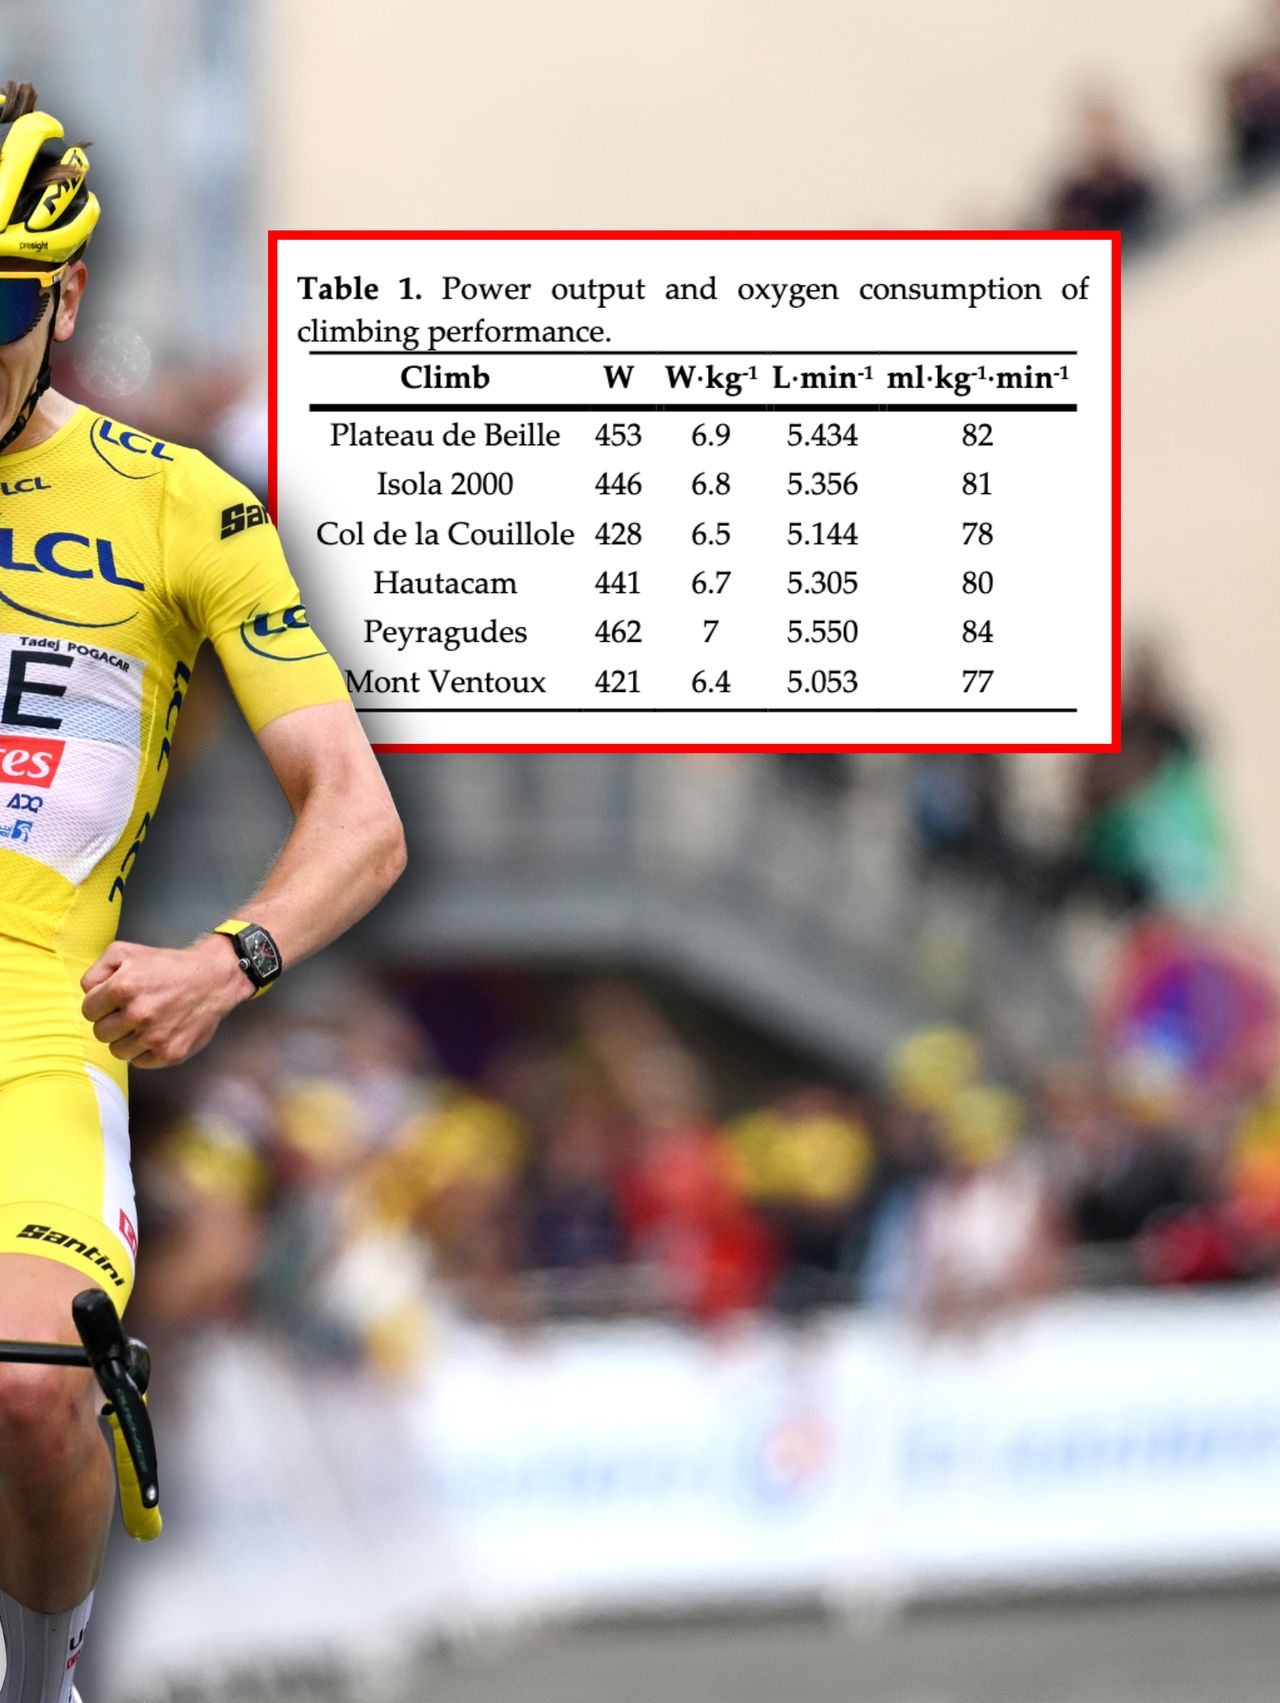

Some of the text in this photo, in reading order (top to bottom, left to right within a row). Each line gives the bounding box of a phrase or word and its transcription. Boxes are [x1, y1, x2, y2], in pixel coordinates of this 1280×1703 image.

[99, 419, 174, 461] LCL
[1, 477, 51, 496] LCL
[20, 636, 130, 672] Tadej POGACAR
[6, 793, 43, 813] ADQ
[16, 1223, 124, 1287] Santini
